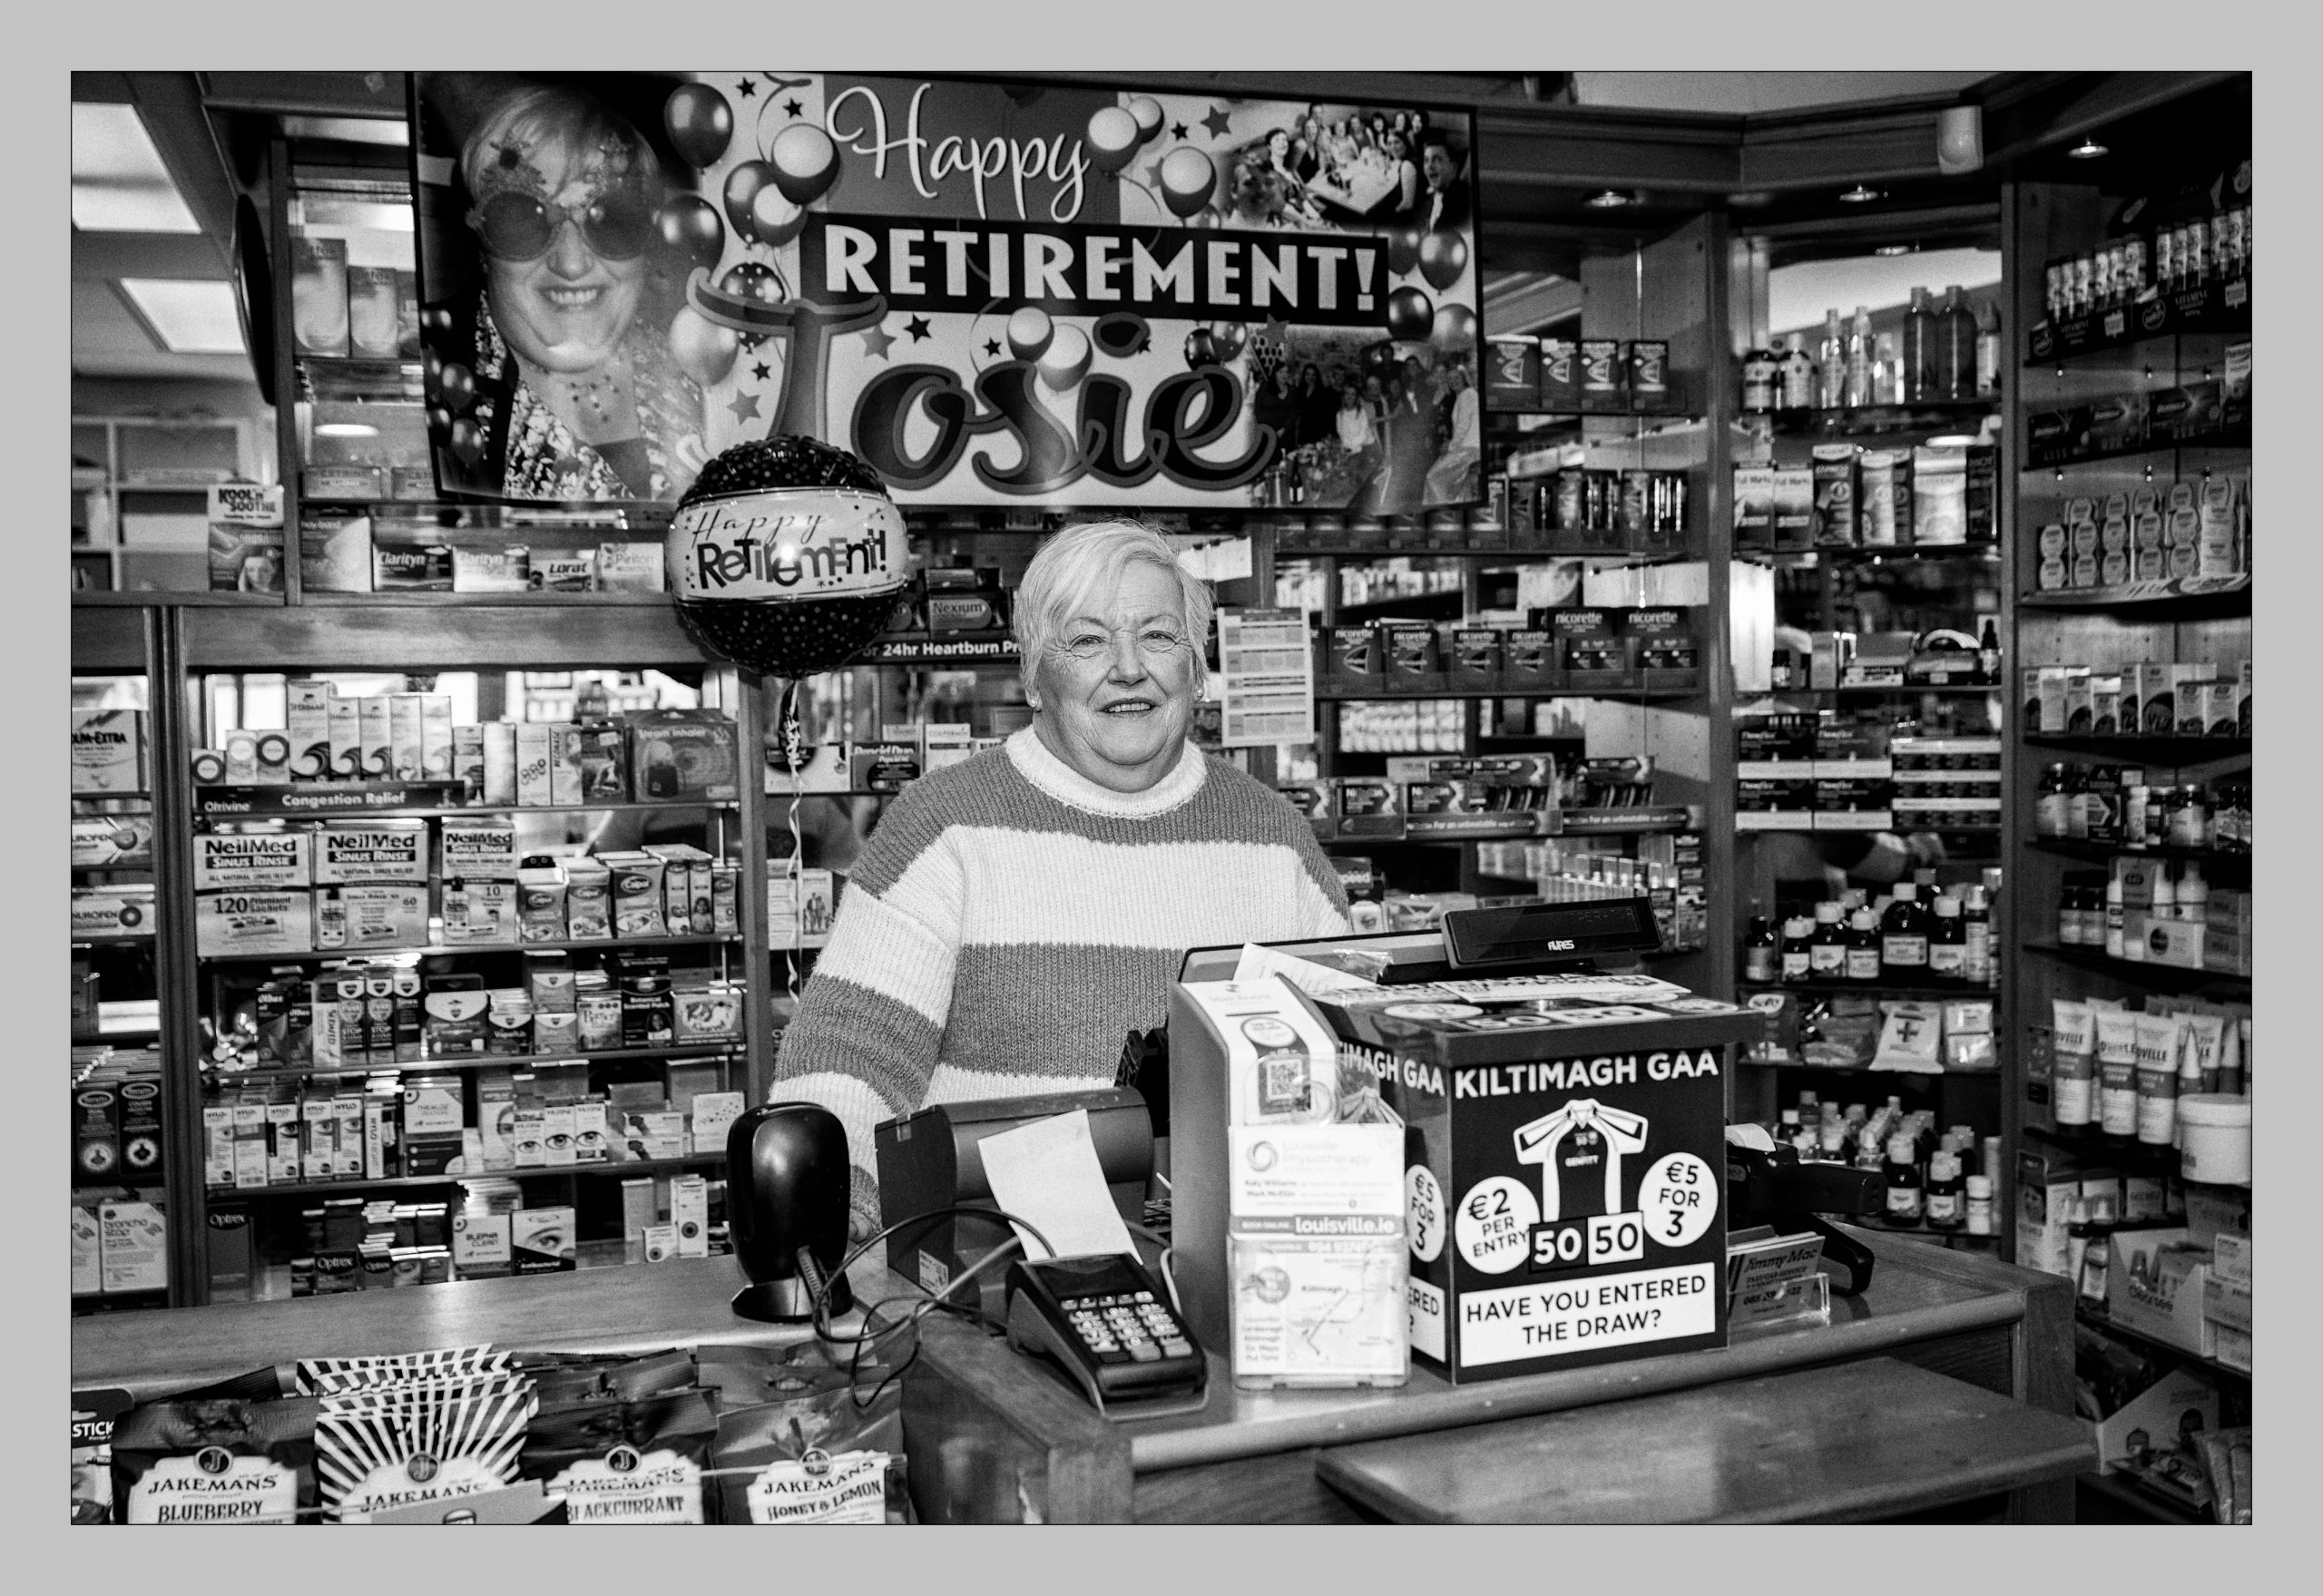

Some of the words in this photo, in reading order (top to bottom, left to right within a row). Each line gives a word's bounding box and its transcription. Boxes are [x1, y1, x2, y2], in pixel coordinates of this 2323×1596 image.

[827, 83, 1090, 222] Happy
[825, 223, 1377, 311] RETIREMENT!
[691, 510, 833, 550] Happy
[378, 551, 426, 566] Clarityn
[933, 602, 984, 613] Nexium
[1555, 612, 1603, 624] nicorette
[1629, 611, 1678, 624] nicorette
[882, 641, 919, 658] 24hr
[922, 641, 1000, 656] Heartburn
[204, 800, 251, 813] Otrivine
[281, 792, 363, 808] Congestion
[366, 791, 407, 805] Relief
[206, 838, 297, 855] NeilMed
[328, 834, 416, 848] NeilMed
[446, 833, 513, 842] NeilMed
[212, 856, 250, 868] SINUS
[252, 855, 290, 867] RINSE
[335, 851, 371, 862] SINUS
[373, 850, 409, 861] RINSE
[403, 896, 417, 906] 60
[486, 886, 501, 896] 10
[213, 897, 248, 915] 120
[1403, 1058, 1446, 1097] GAA
[1455, 1056, 1636, 1100] KILTIMAGH
[1646, 1048, 1720, 1081] GAA
[1665, 1160, 1700, 1185] €5
[1414, 1173, 1435, 1203] €5
[1659, 1186, 1701, 1209] FOR
[1411, 1195, 1435, 1225] FOR
[1467, 1188, 1512, 1220] €2
[210, 1213, 247, 1225] Optrex
[1295, 1217, 1396, 1234] louisville.ie
[1482, 1217, 1515, 1236] PER
[1665, 1210, 1683, 1239] 3
[1416, 1221, 1426, 1251] 3
[1472, 1226, 1530, 1258] ENTRY
[1533, 1228, 1583, 1262] 50
[1593, 1221, 1639, 1255] 50
[318, 1257, 354, 1269] Optrex
[1466, 1297, 1532, 1324] HAVE
[1540, 1286, 1590, 1312] YOU
[1599, 1274, 1707, 1306] ENTERED
[1522, 1324, 1569, 1346] THE
[1576, 1307, 1662, 1340] DRAW?
[148, 1474, 279, 1494] JAKEMANS
[567, 1467, 685, 1493] JAKEMANS
[764, 1460, 875, 1494] JAKEMANS
[767, 1503, 817, 1522] HONEY
[832, 1480, 883, 1508] LEMON
[158, 1500, 264, 1524] BLUEBERRY
